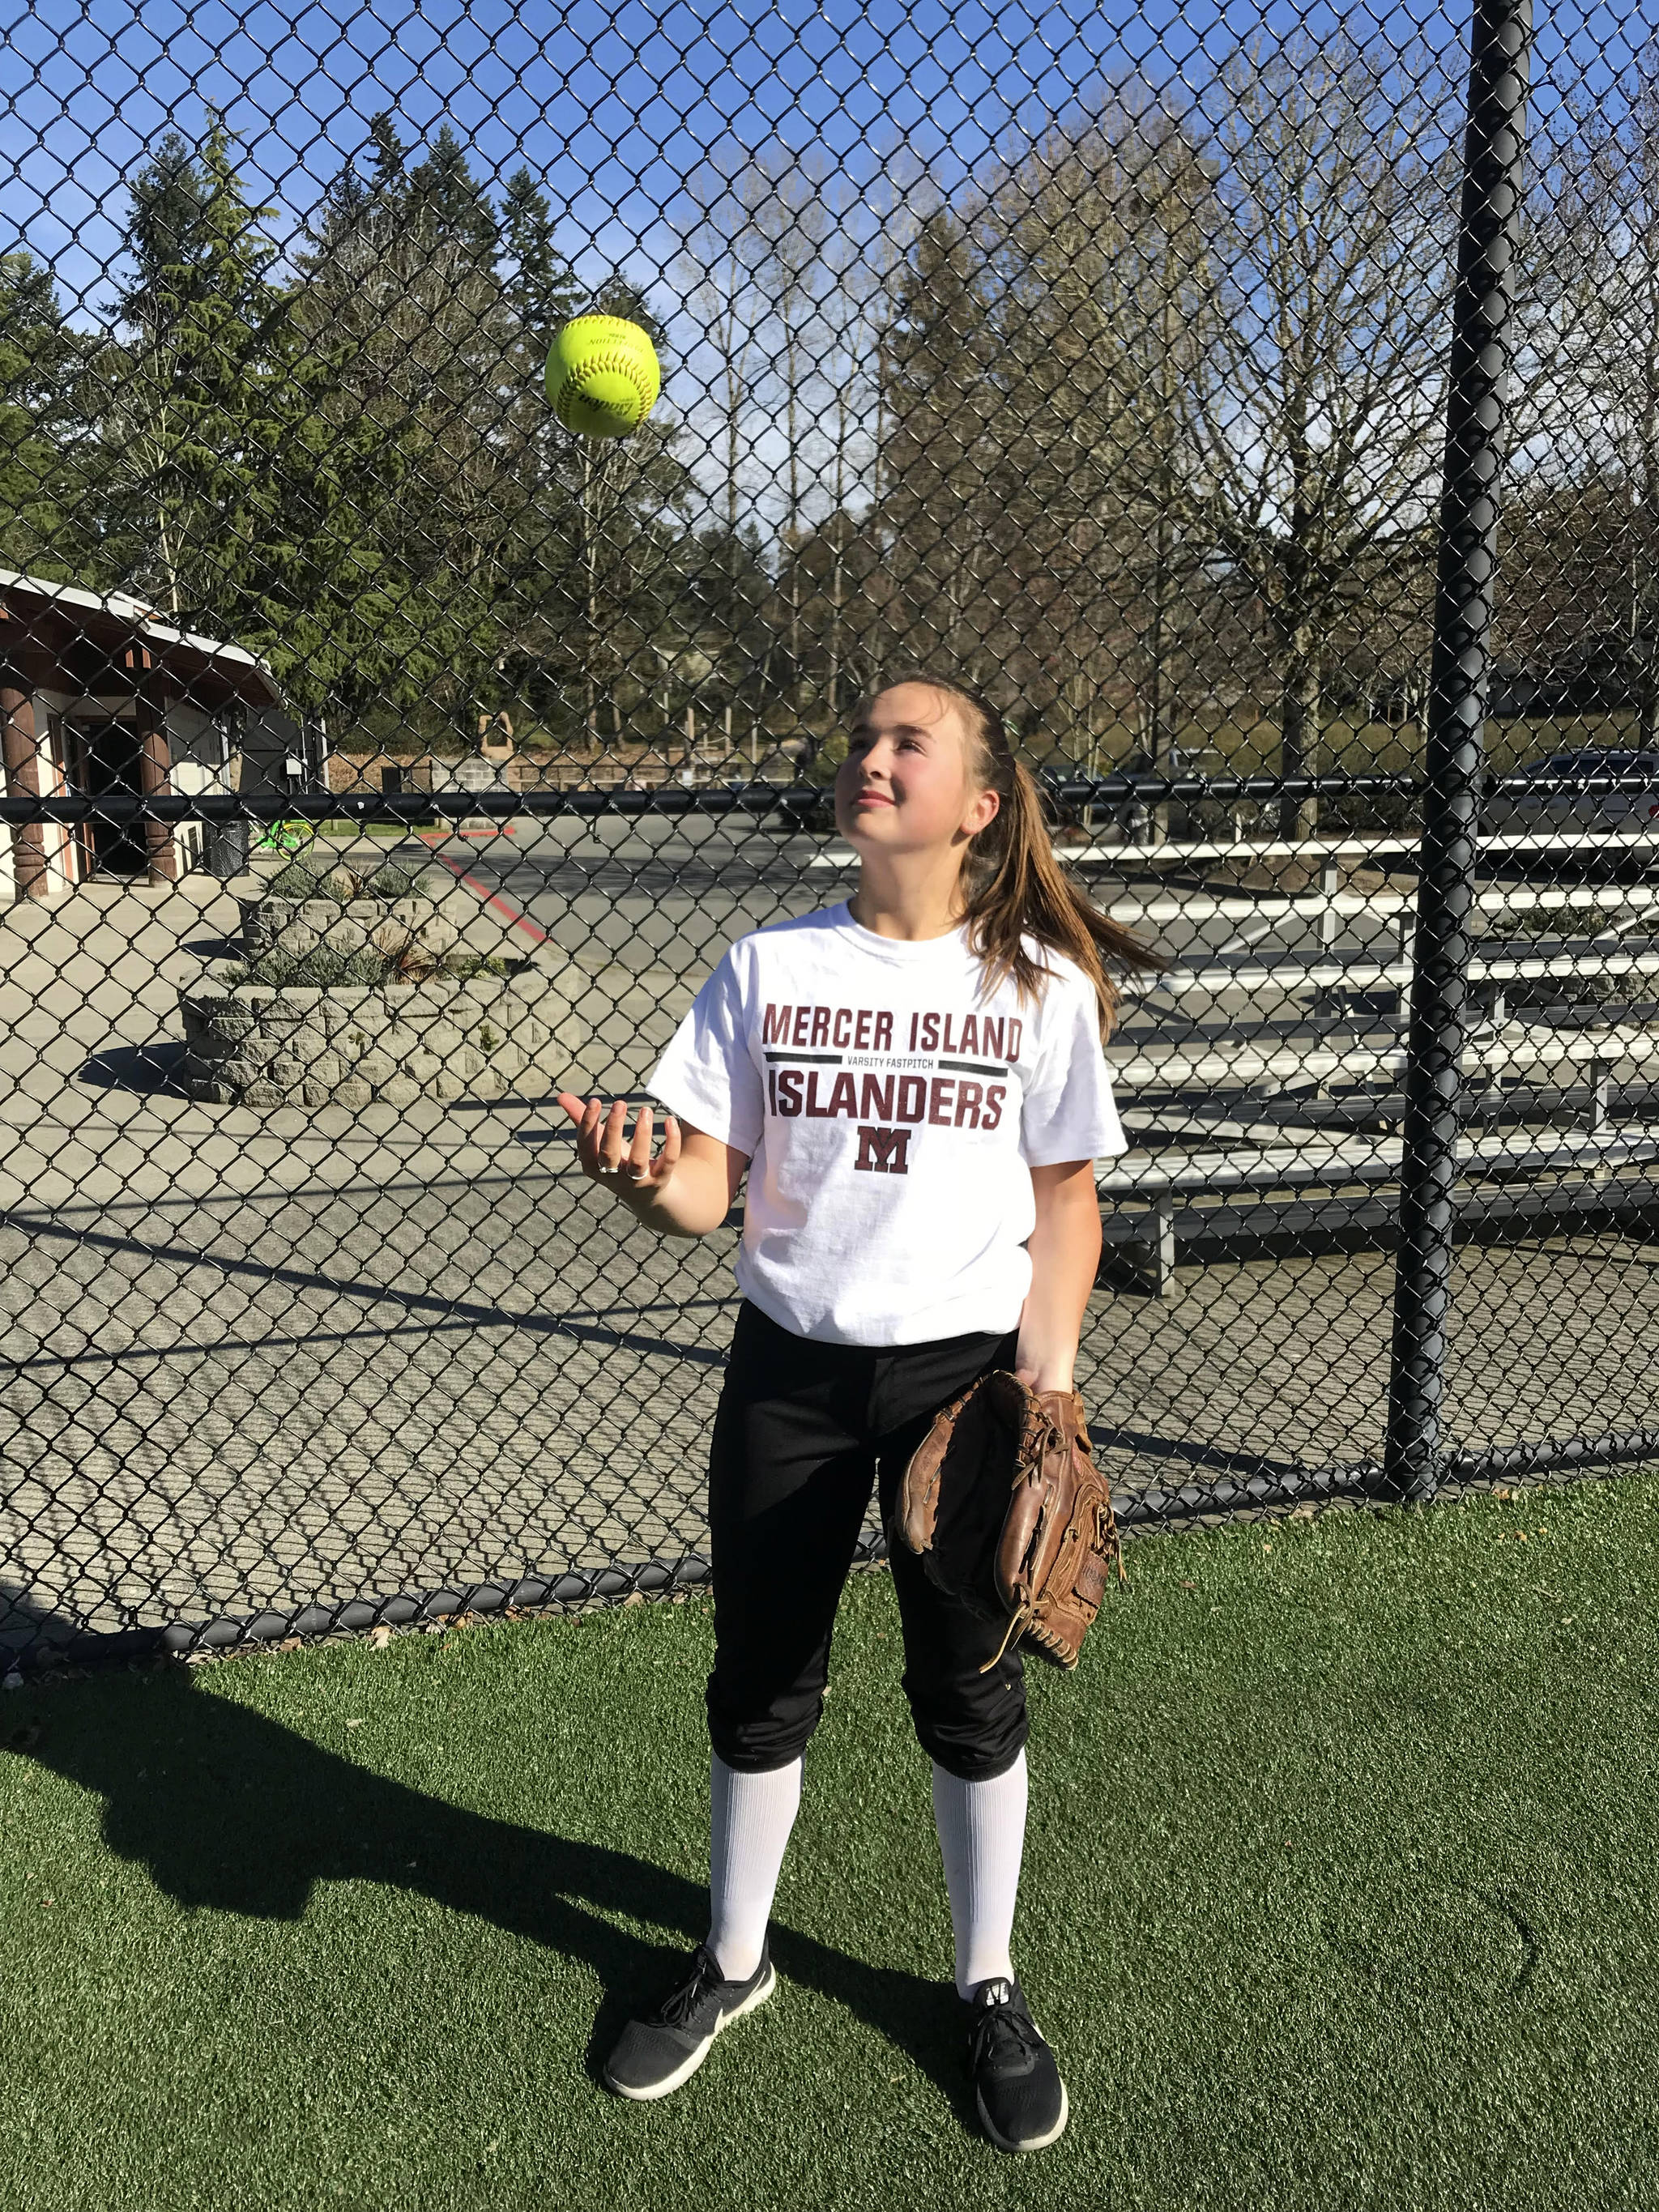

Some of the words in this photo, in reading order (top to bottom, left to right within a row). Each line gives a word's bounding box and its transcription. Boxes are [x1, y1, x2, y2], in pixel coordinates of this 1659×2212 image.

[762, 1003, 893, 1051] MERCER
[910, 1012, 1023, 1063] ISLAND
[847, 1056, 884, 1068] VARSITY
[886, 1058, 933, 1069] FASTPITCH
[769, 1069, 1006, 1131] ISLANDERS
